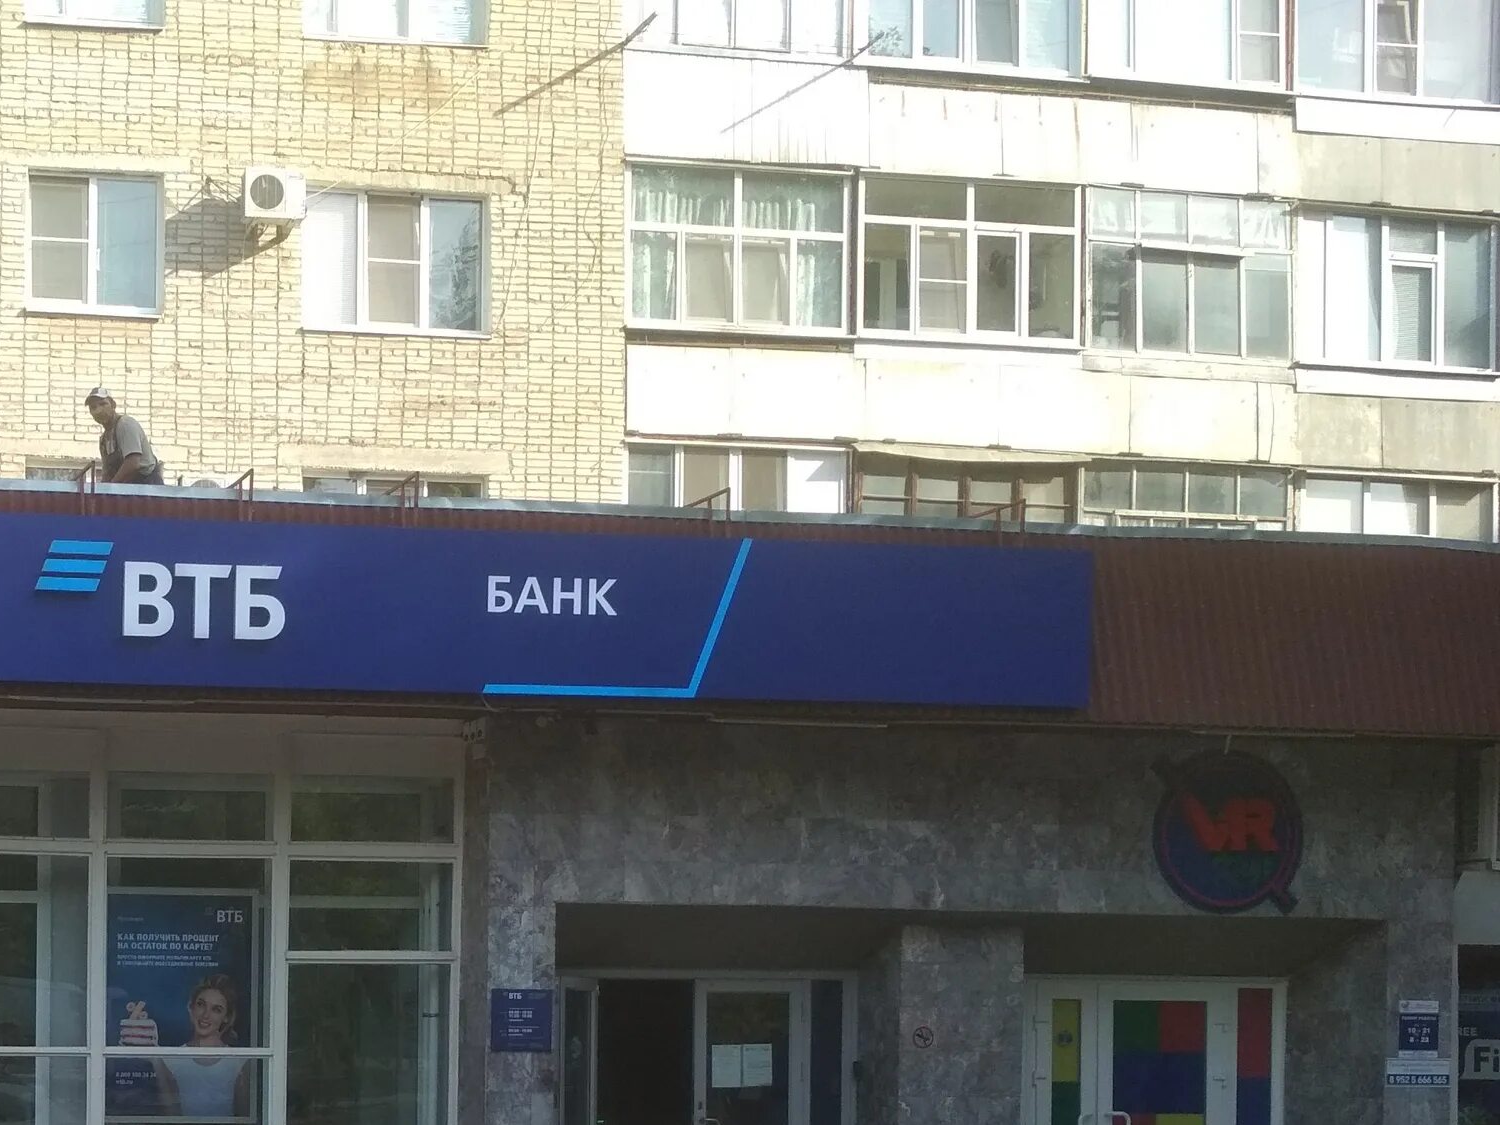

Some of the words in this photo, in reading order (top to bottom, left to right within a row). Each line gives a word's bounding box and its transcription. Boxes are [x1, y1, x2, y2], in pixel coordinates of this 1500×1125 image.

[122, 561, 286, 640] ВТБ
[487, 576, 618, 616] БАНК
[216, 909, 243, 923] ВТБ
[117, 933, 134, 941] КАК
[136, 933, 180, 942] ПОЛУЧИТЬ
[182, 934, 220, 943] ПРОЦЕНТ
[131, 942, 168, 950] ОСТАТОК
[1396, 1076, 1410, 1084] 952
[1411, 1076, 1416, 1084] 5
[1417, 1076, 1432, 1084] 666
